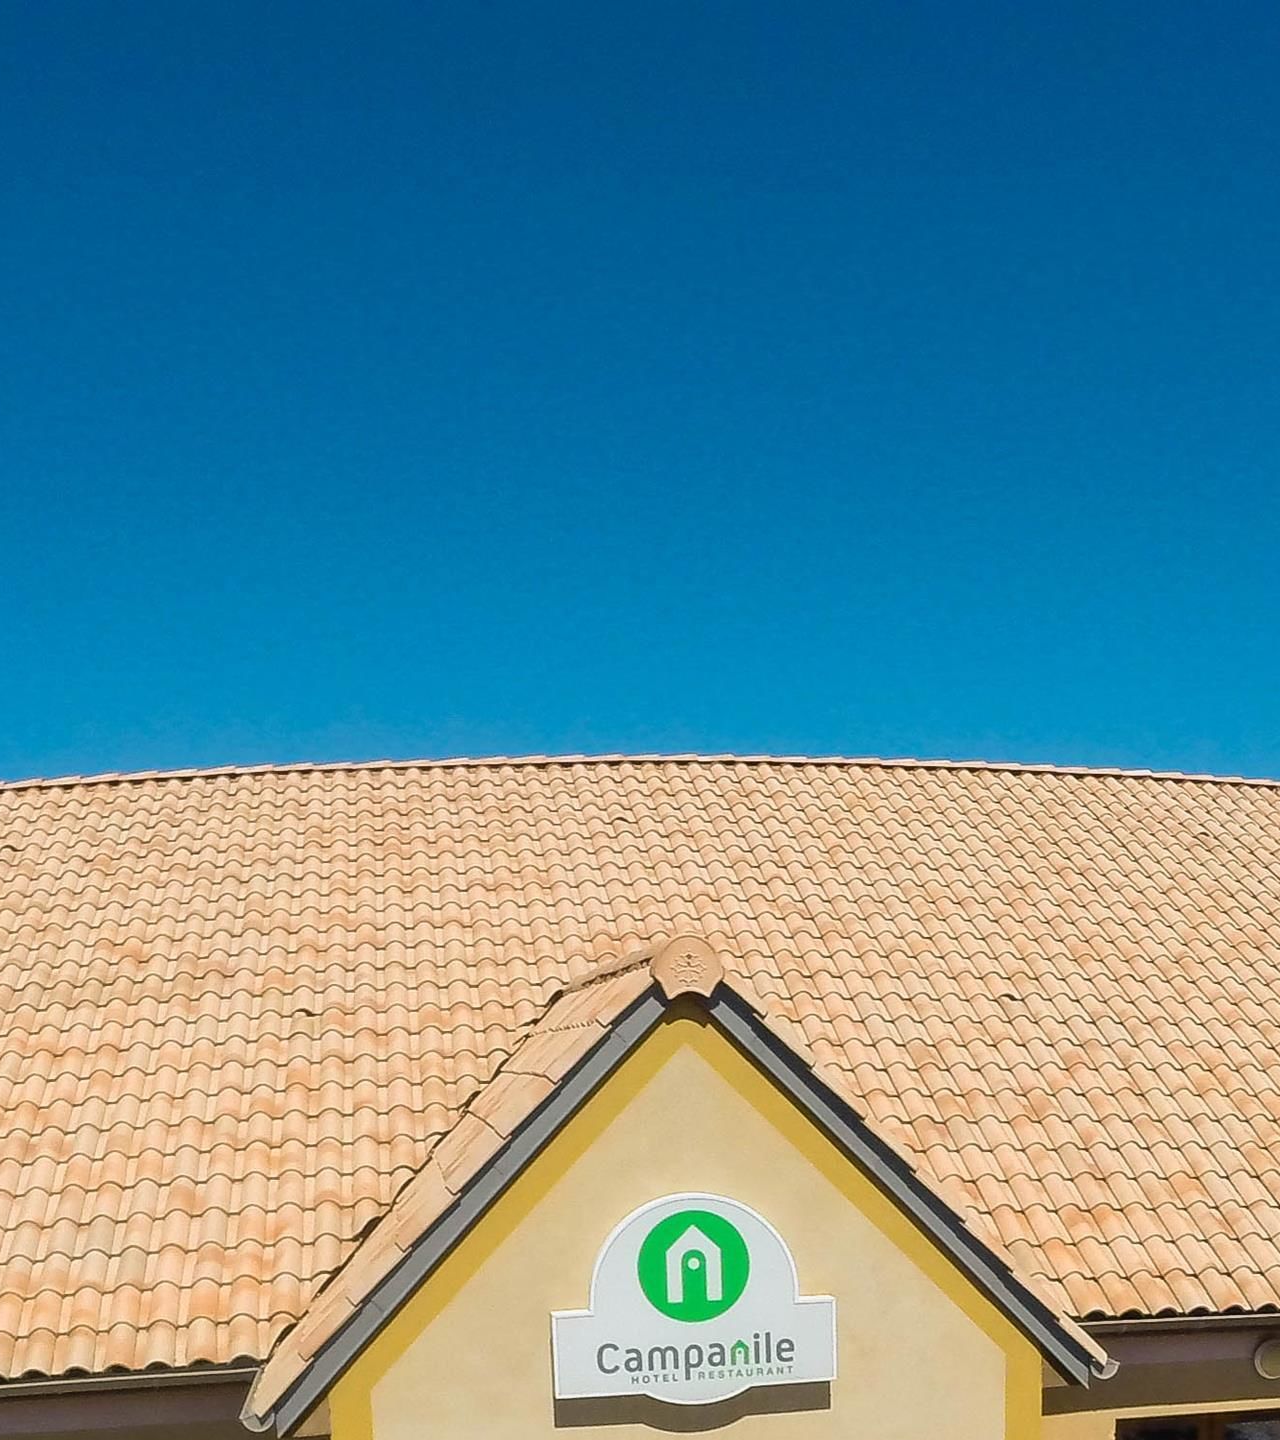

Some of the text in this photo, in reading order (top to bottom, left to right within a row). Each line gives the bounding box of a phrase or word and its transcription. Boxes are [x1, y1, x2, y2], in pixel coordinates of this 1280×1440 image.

[596, 1331, 796, 1381] Campanile
[631, 1365, 795, 1385] HOTEL RESTAURANT
